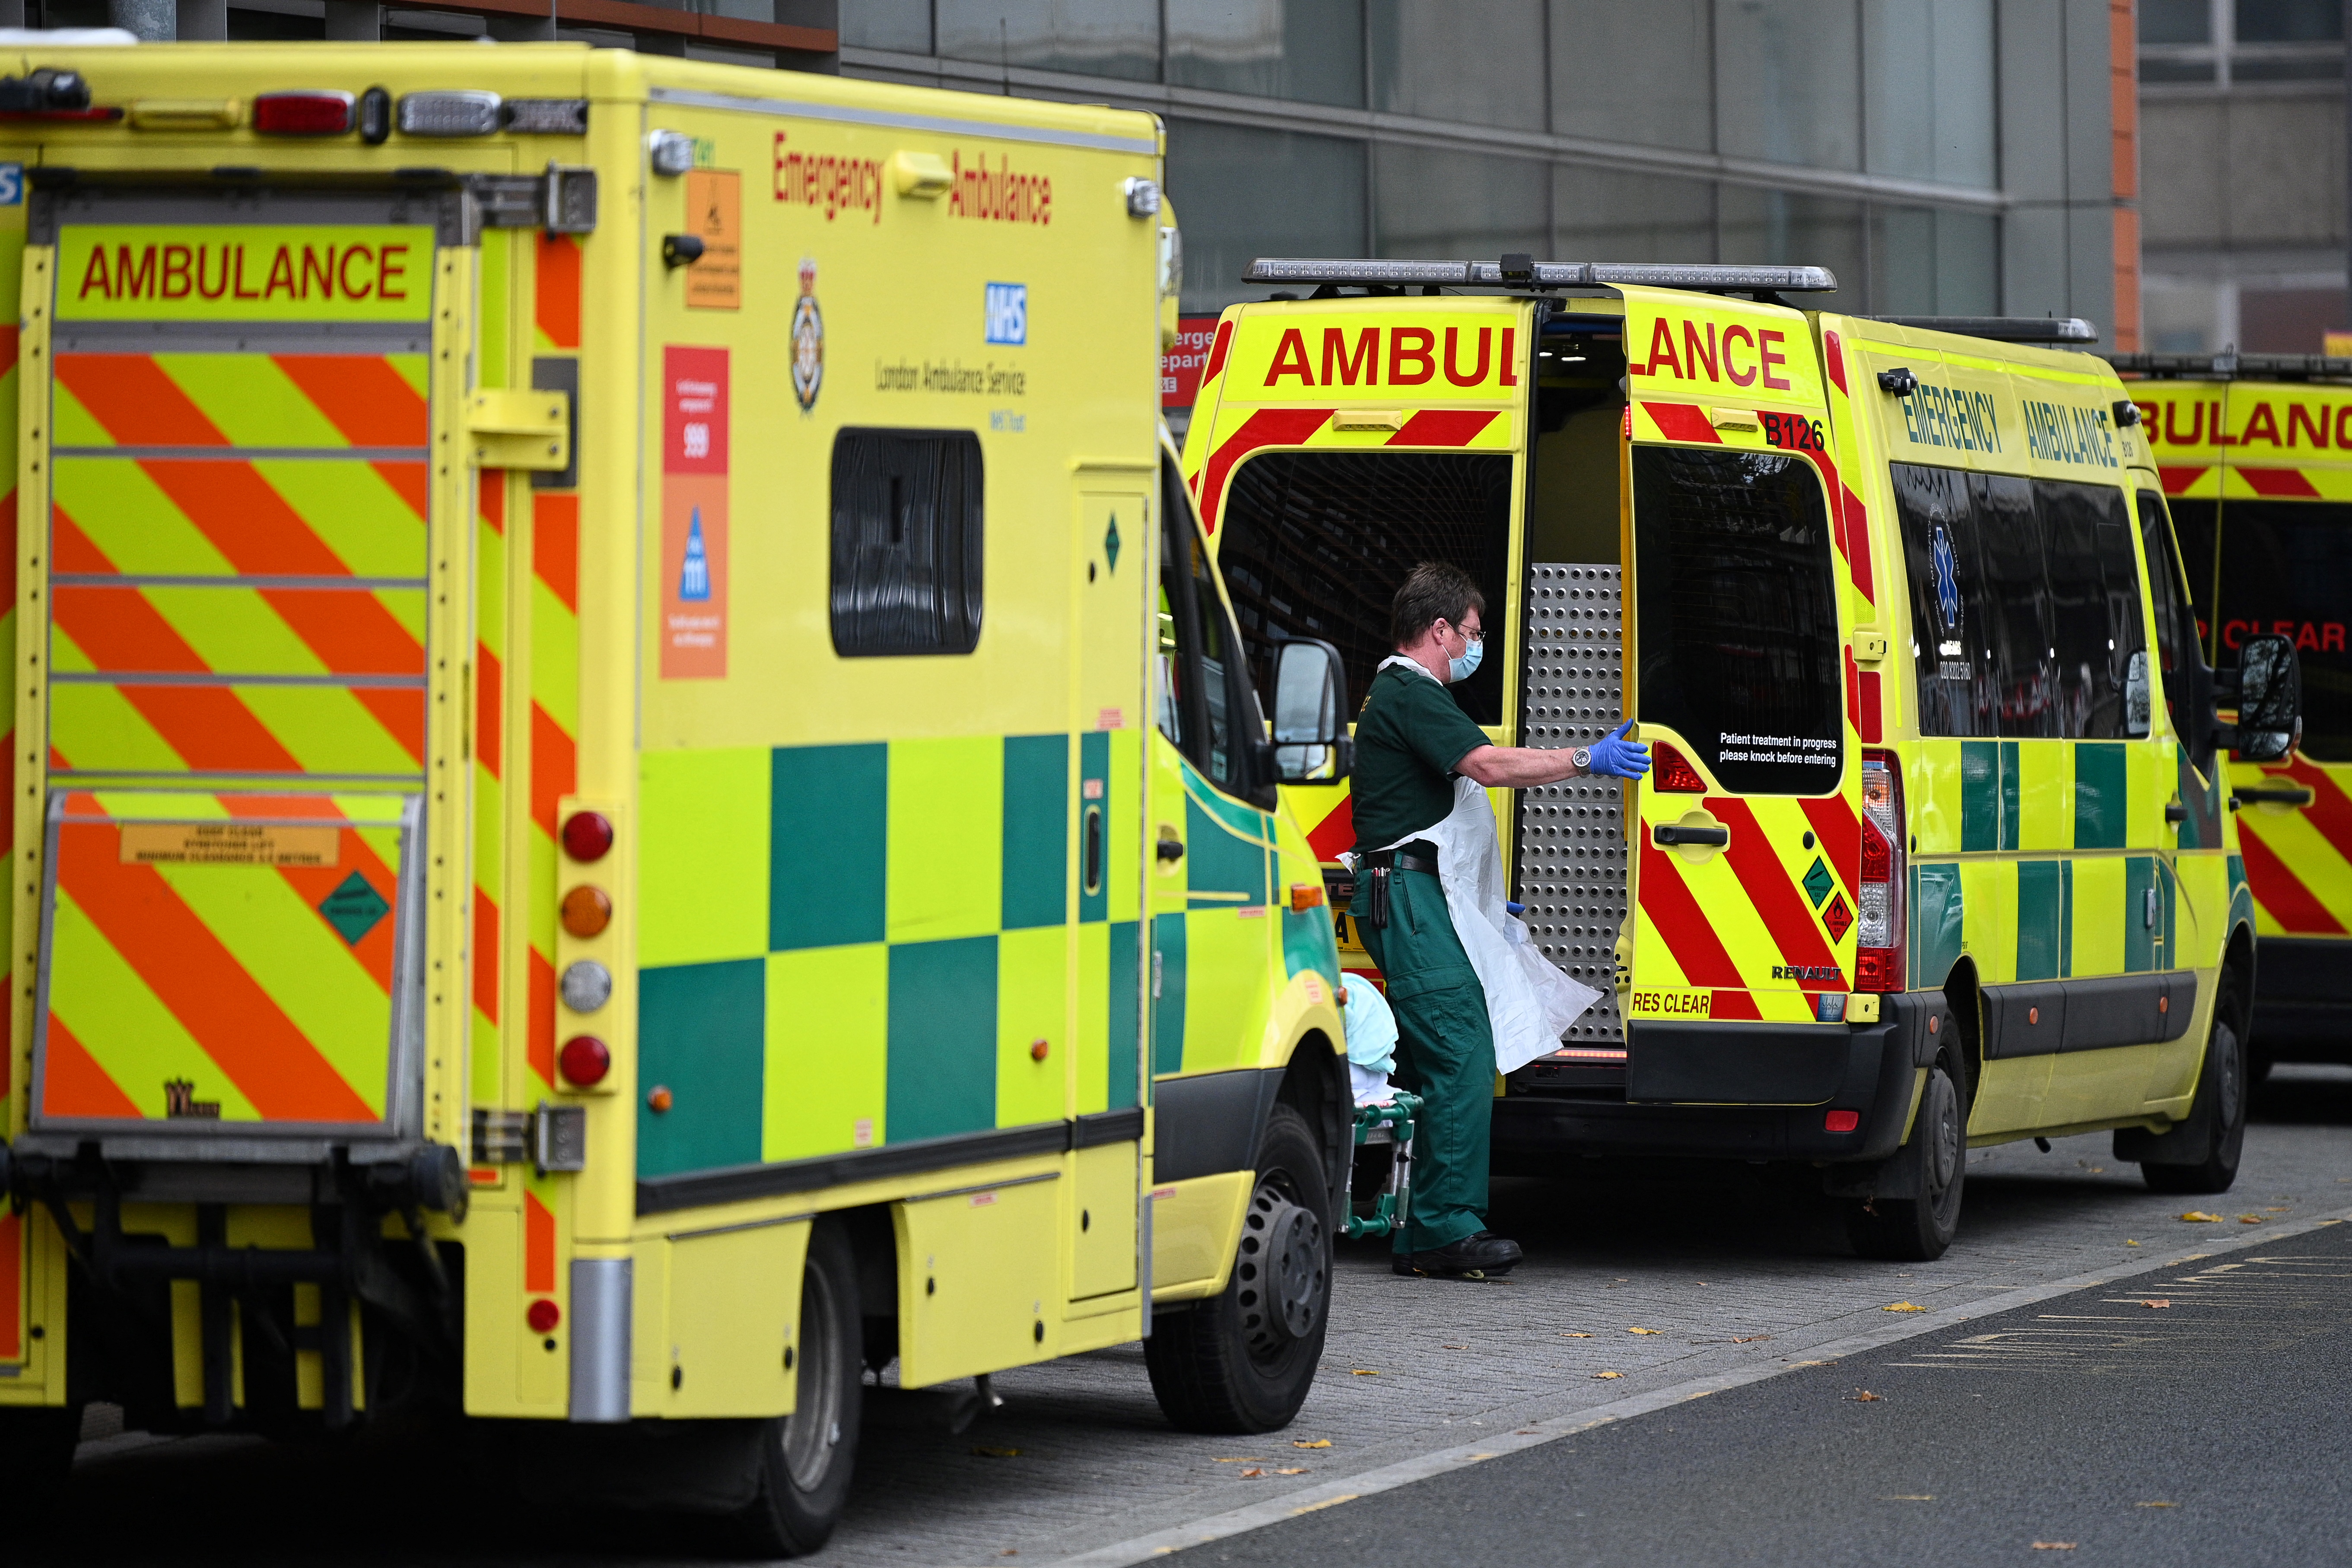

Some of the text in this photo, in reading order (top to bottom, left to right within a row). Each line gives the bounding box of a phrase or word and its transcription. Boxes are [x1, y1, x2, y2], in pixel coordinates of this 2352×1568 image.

[775, 131, 1051, 226] Emergency Ambulance
[79, 244, 408, 299] AMBULANCE
[986, 286, 1025, 341] NHS
[875, 359, 1025, 395] London Ambulance Service
[1765, 414, 1824, 451] B126
[1902, 384, 2118, 468] EMERGENCY AMBULANCE
[2122, 441, 2133, 457] B126
[1940, 661, 1971, 681] 020 8202 5160
[1721, 732, 1836, 751] Patient treatment in progress
[1720, 749, 1836, 767] please knock before entering
[1772, 965, 1841, 980] RENAULT
[1633, 993, 1709, 1014] RES CLEAR
